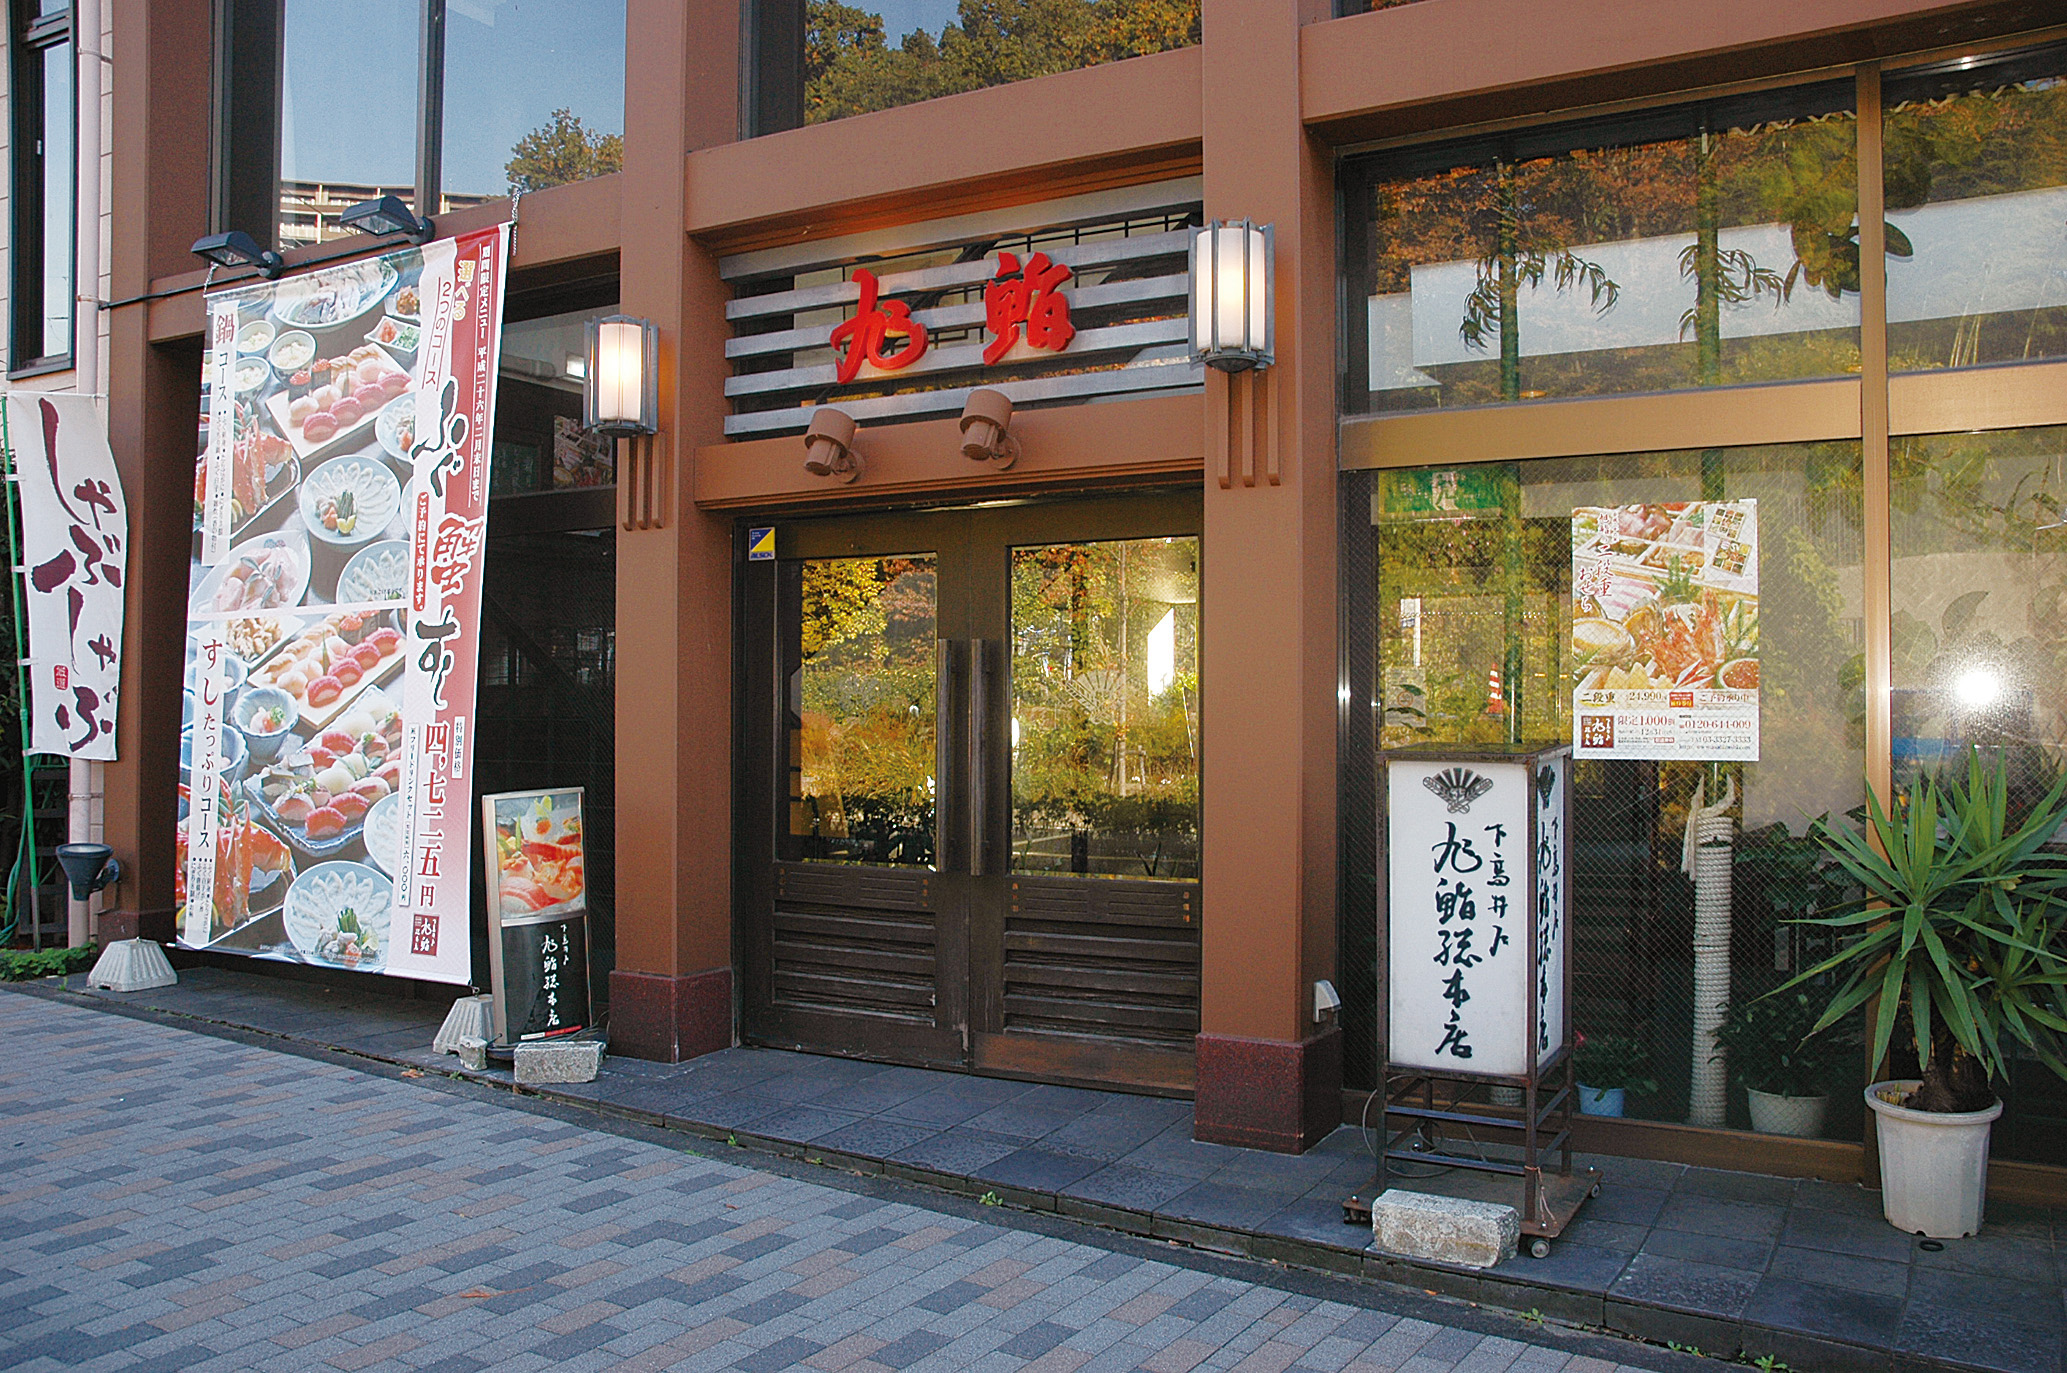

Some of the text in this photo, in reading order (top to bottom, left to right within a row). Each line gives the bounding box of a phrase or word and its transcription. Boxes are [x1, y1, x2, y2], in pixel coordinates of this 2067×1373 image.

[425, 281, 452, 385] 2つのコース
[453, 259, 476, 321] 選べる
[31, 397, 122, 753] しゃぶしゃぶ
[415, 492, 429, 610] ご予約にて承ります。
[198, 638, 223, 849] すしたっぷりコース
